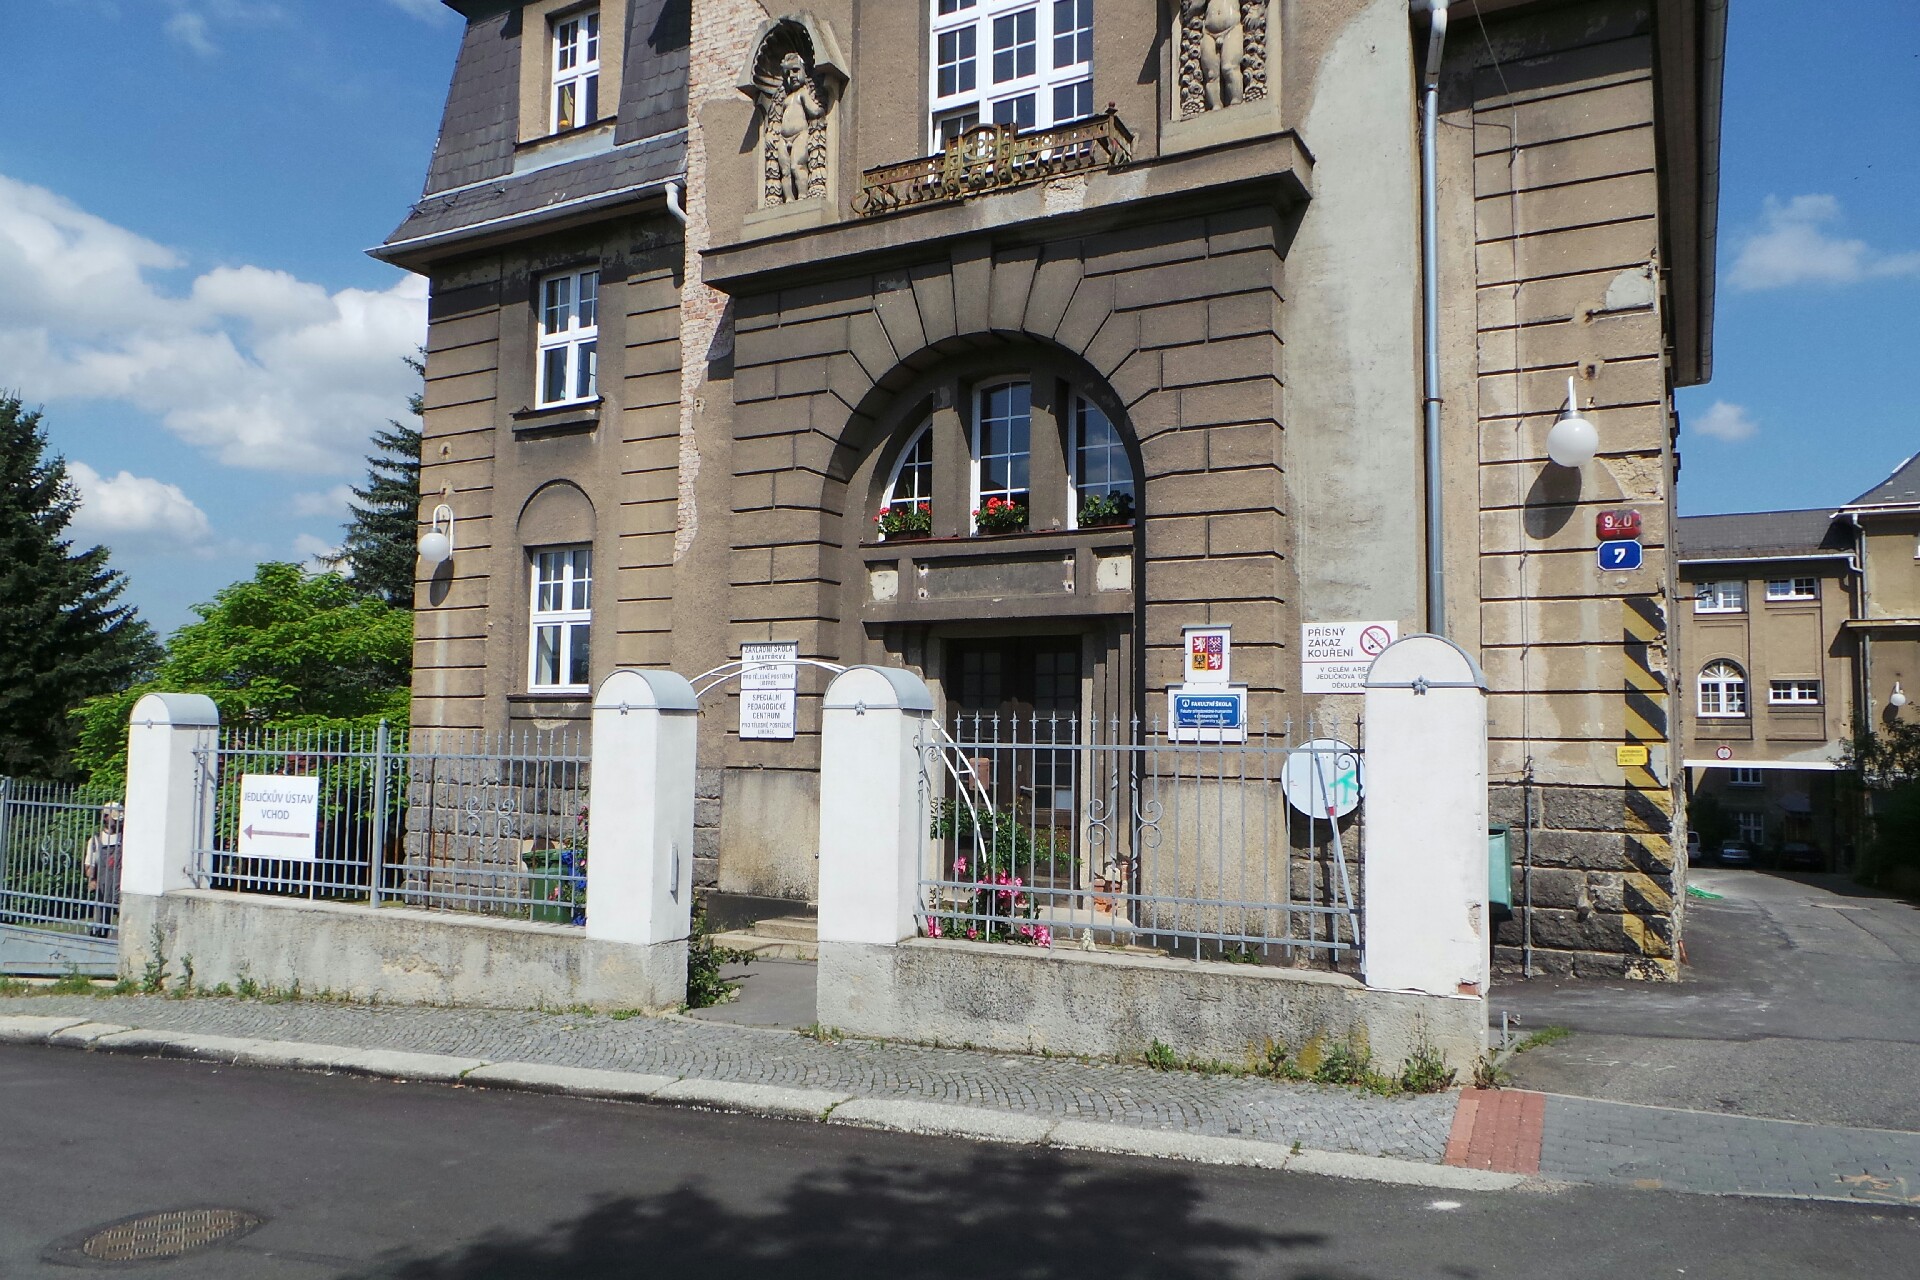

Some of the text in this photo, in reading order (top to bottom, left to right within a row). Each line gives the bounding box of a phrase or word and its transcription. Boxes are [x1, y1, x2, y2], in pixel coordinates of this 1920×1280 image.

[1614, 548, 1626, 564] 7
[1308, 626, 1346, 636] PŘÍSNÝ
[1308, 637, 1341, 647] ZÁKAZ
[1308, 647, 1354, 658] KOUŘENÍ
[244, 790, 314, 804] JEDLIČKŮV ÚSTAV
[262, 808, 290, 820] VCHOD
